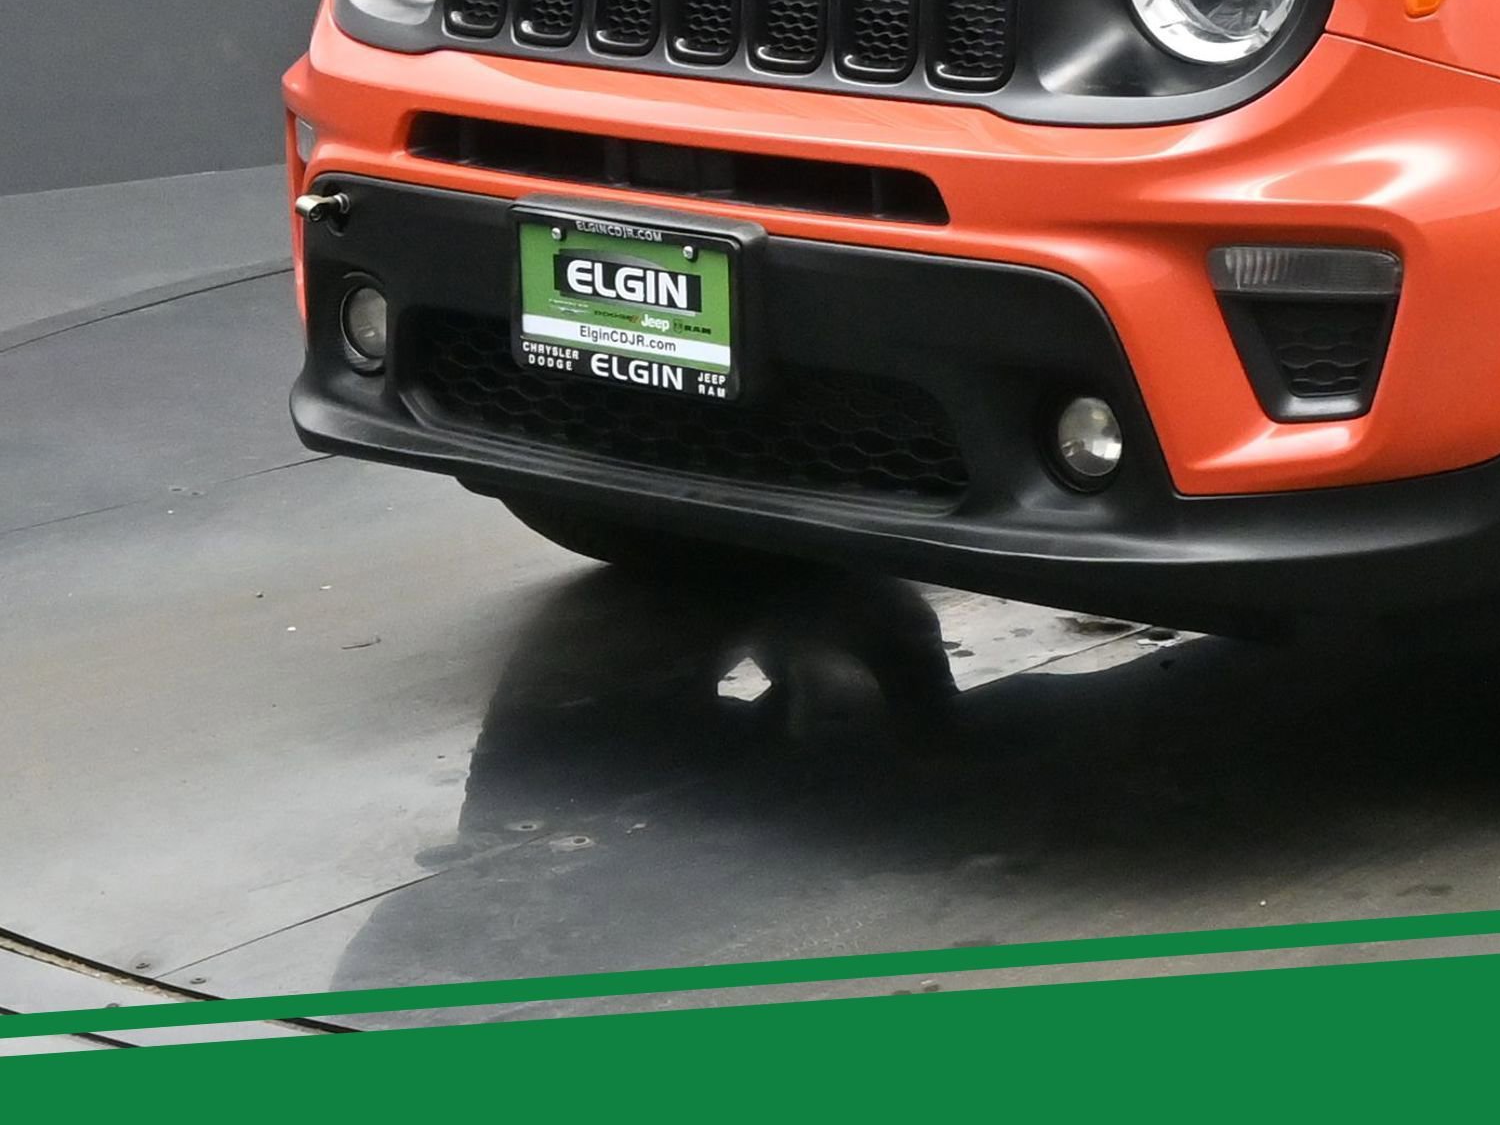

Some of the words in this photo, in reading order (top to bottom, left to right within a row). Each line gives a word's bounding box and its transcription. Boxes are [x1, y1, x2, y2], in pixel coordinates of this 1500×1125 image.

[576, 220, 662, 242] ELGINCDJR.COM
[567, 259, 687, 308] ELGIN
[641, 313, 670, 332] Jeep
[580, 325, 676, 351] ElginCDJR.com
[522, 341, 580, 360] CHRYSLER
[528, 353, 573, 371] DODGE
[591, 354, 683, 390] ELGIN
[698, 373, 726, 385] JEEP
[698, 384, 726, 398] RAM
